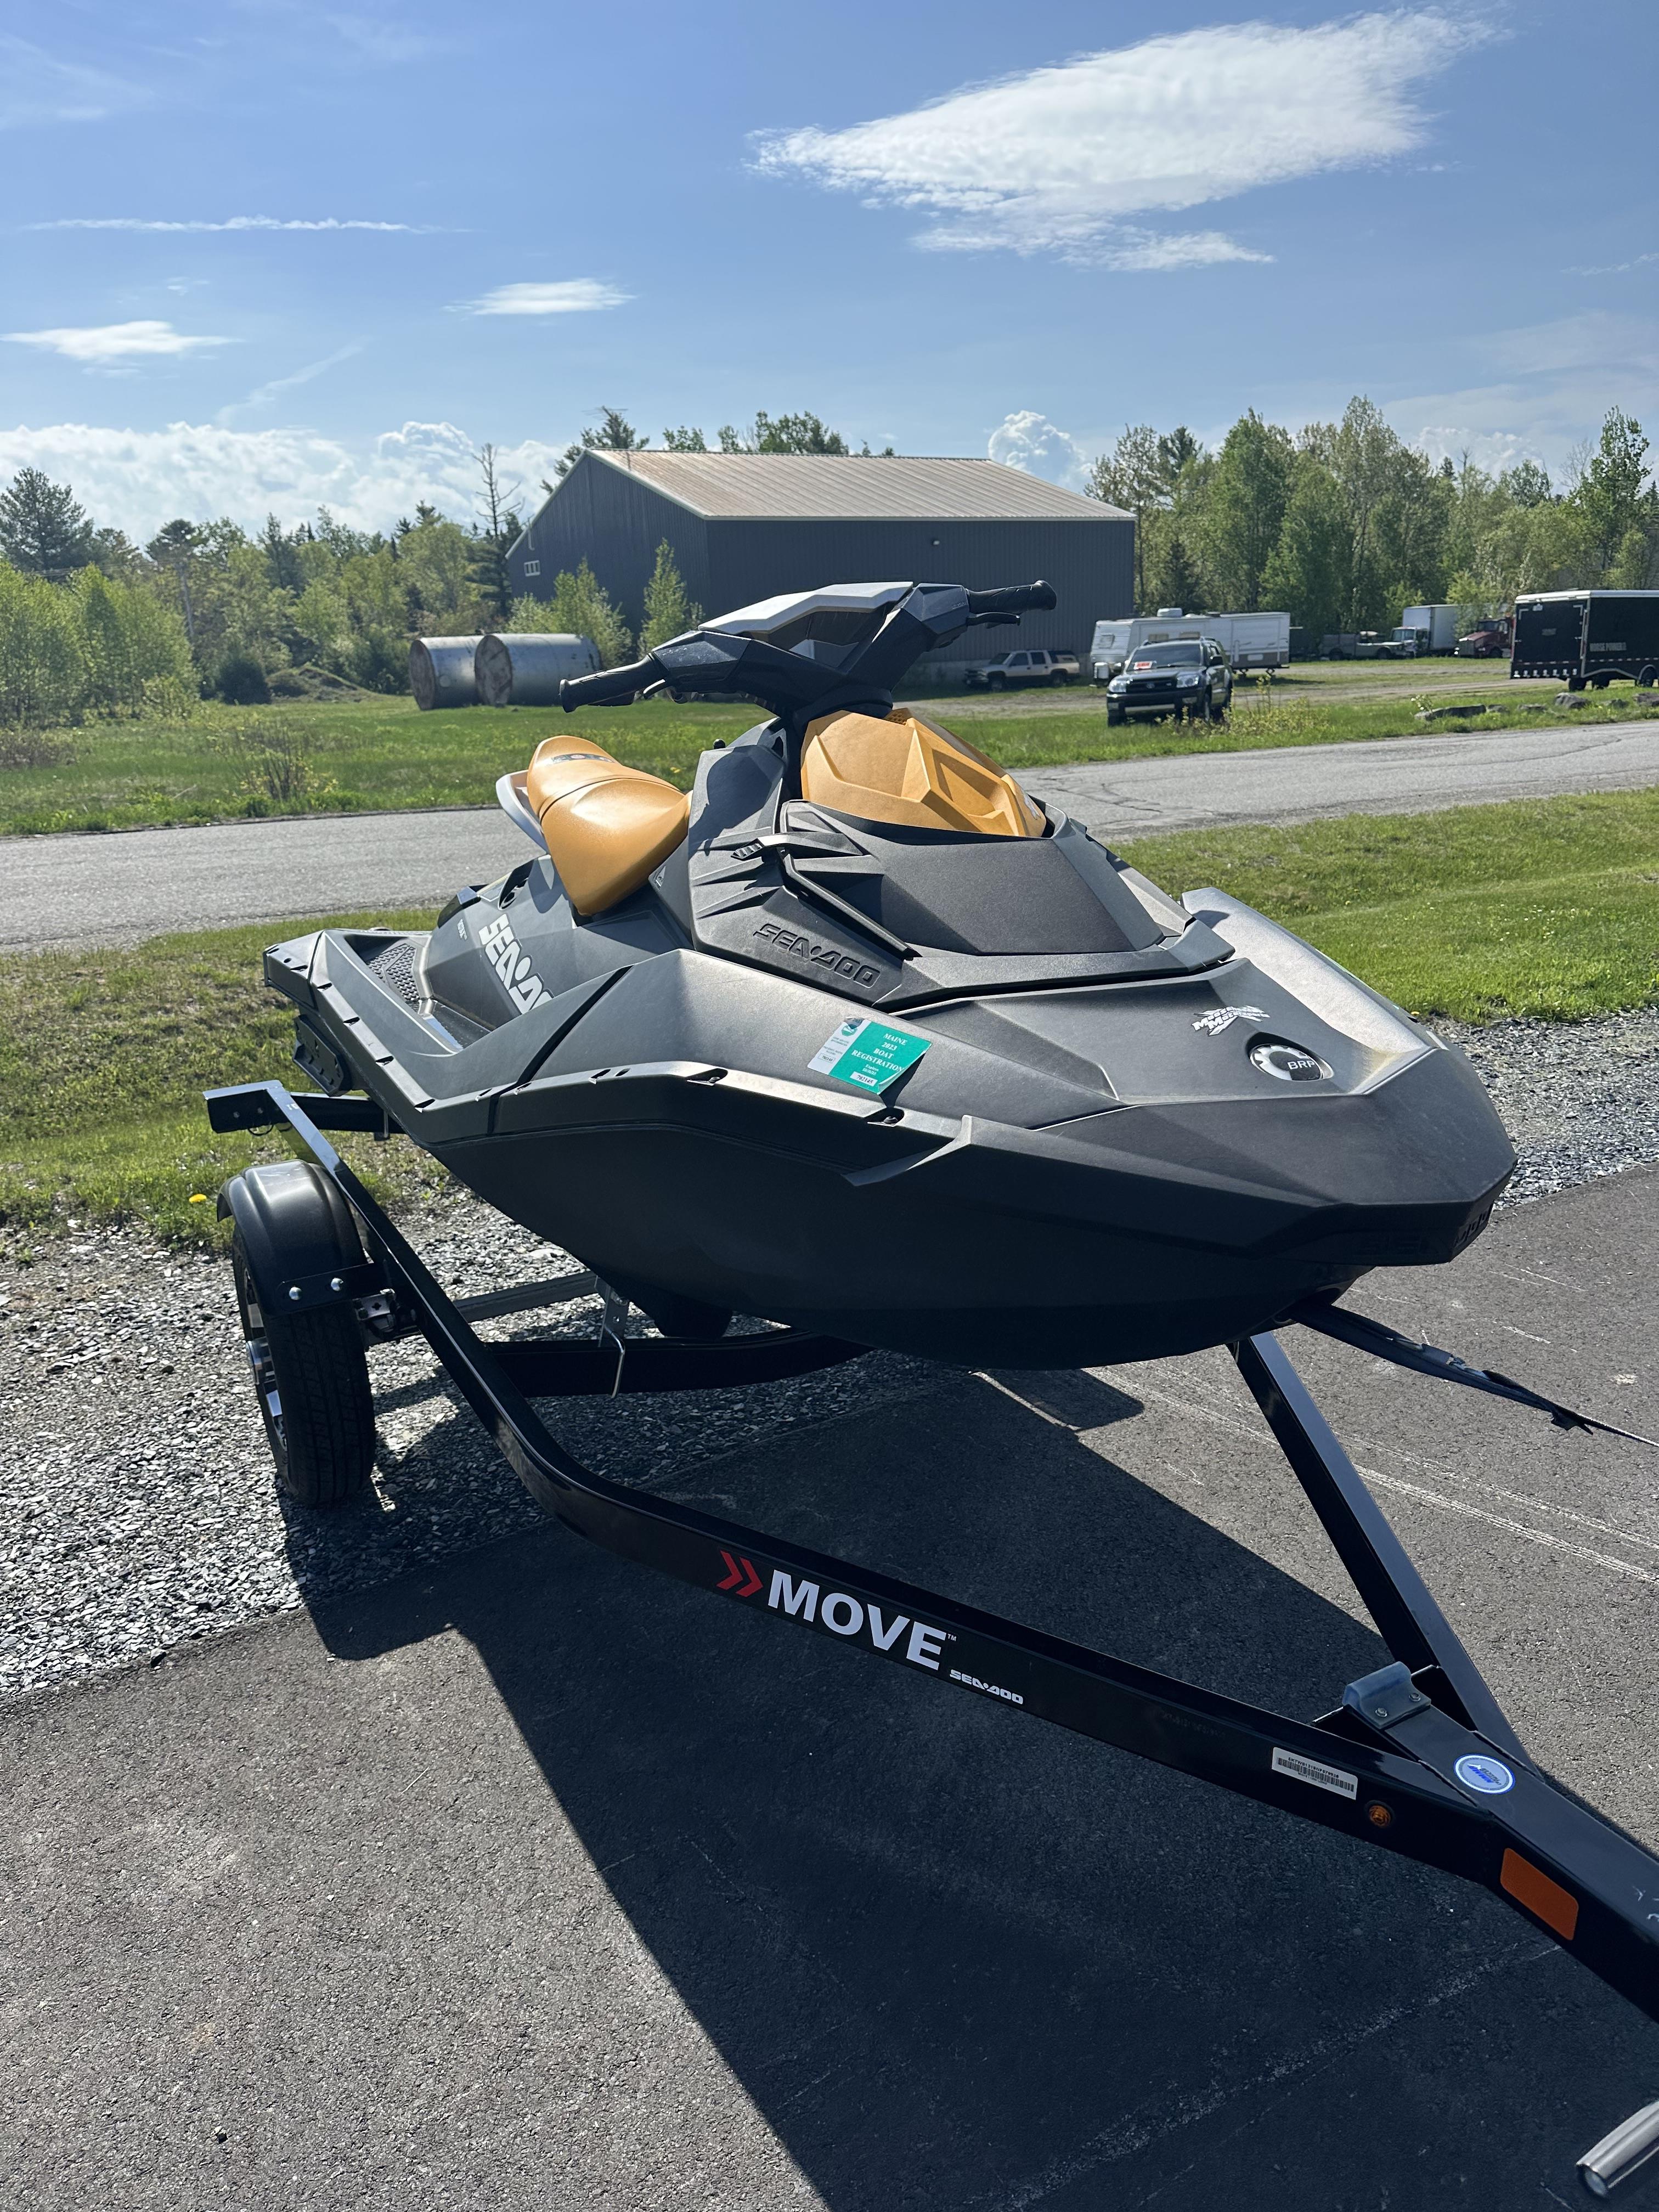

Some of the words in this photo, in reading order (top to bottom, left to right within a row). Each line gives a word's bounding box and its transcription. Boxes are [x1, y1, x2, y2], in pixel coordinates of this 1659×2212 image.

[883, 1033, 908, 1046] MAINE
[882, 1042, 898, 1051] 2023
[873, 1048, 894, 1059] BOAT
[851, 1049, 905, 1072] REGISTRATION
[1287, 1060, 1315, 1070] BRP
[768, 1570, 946, 1671] MOVE
